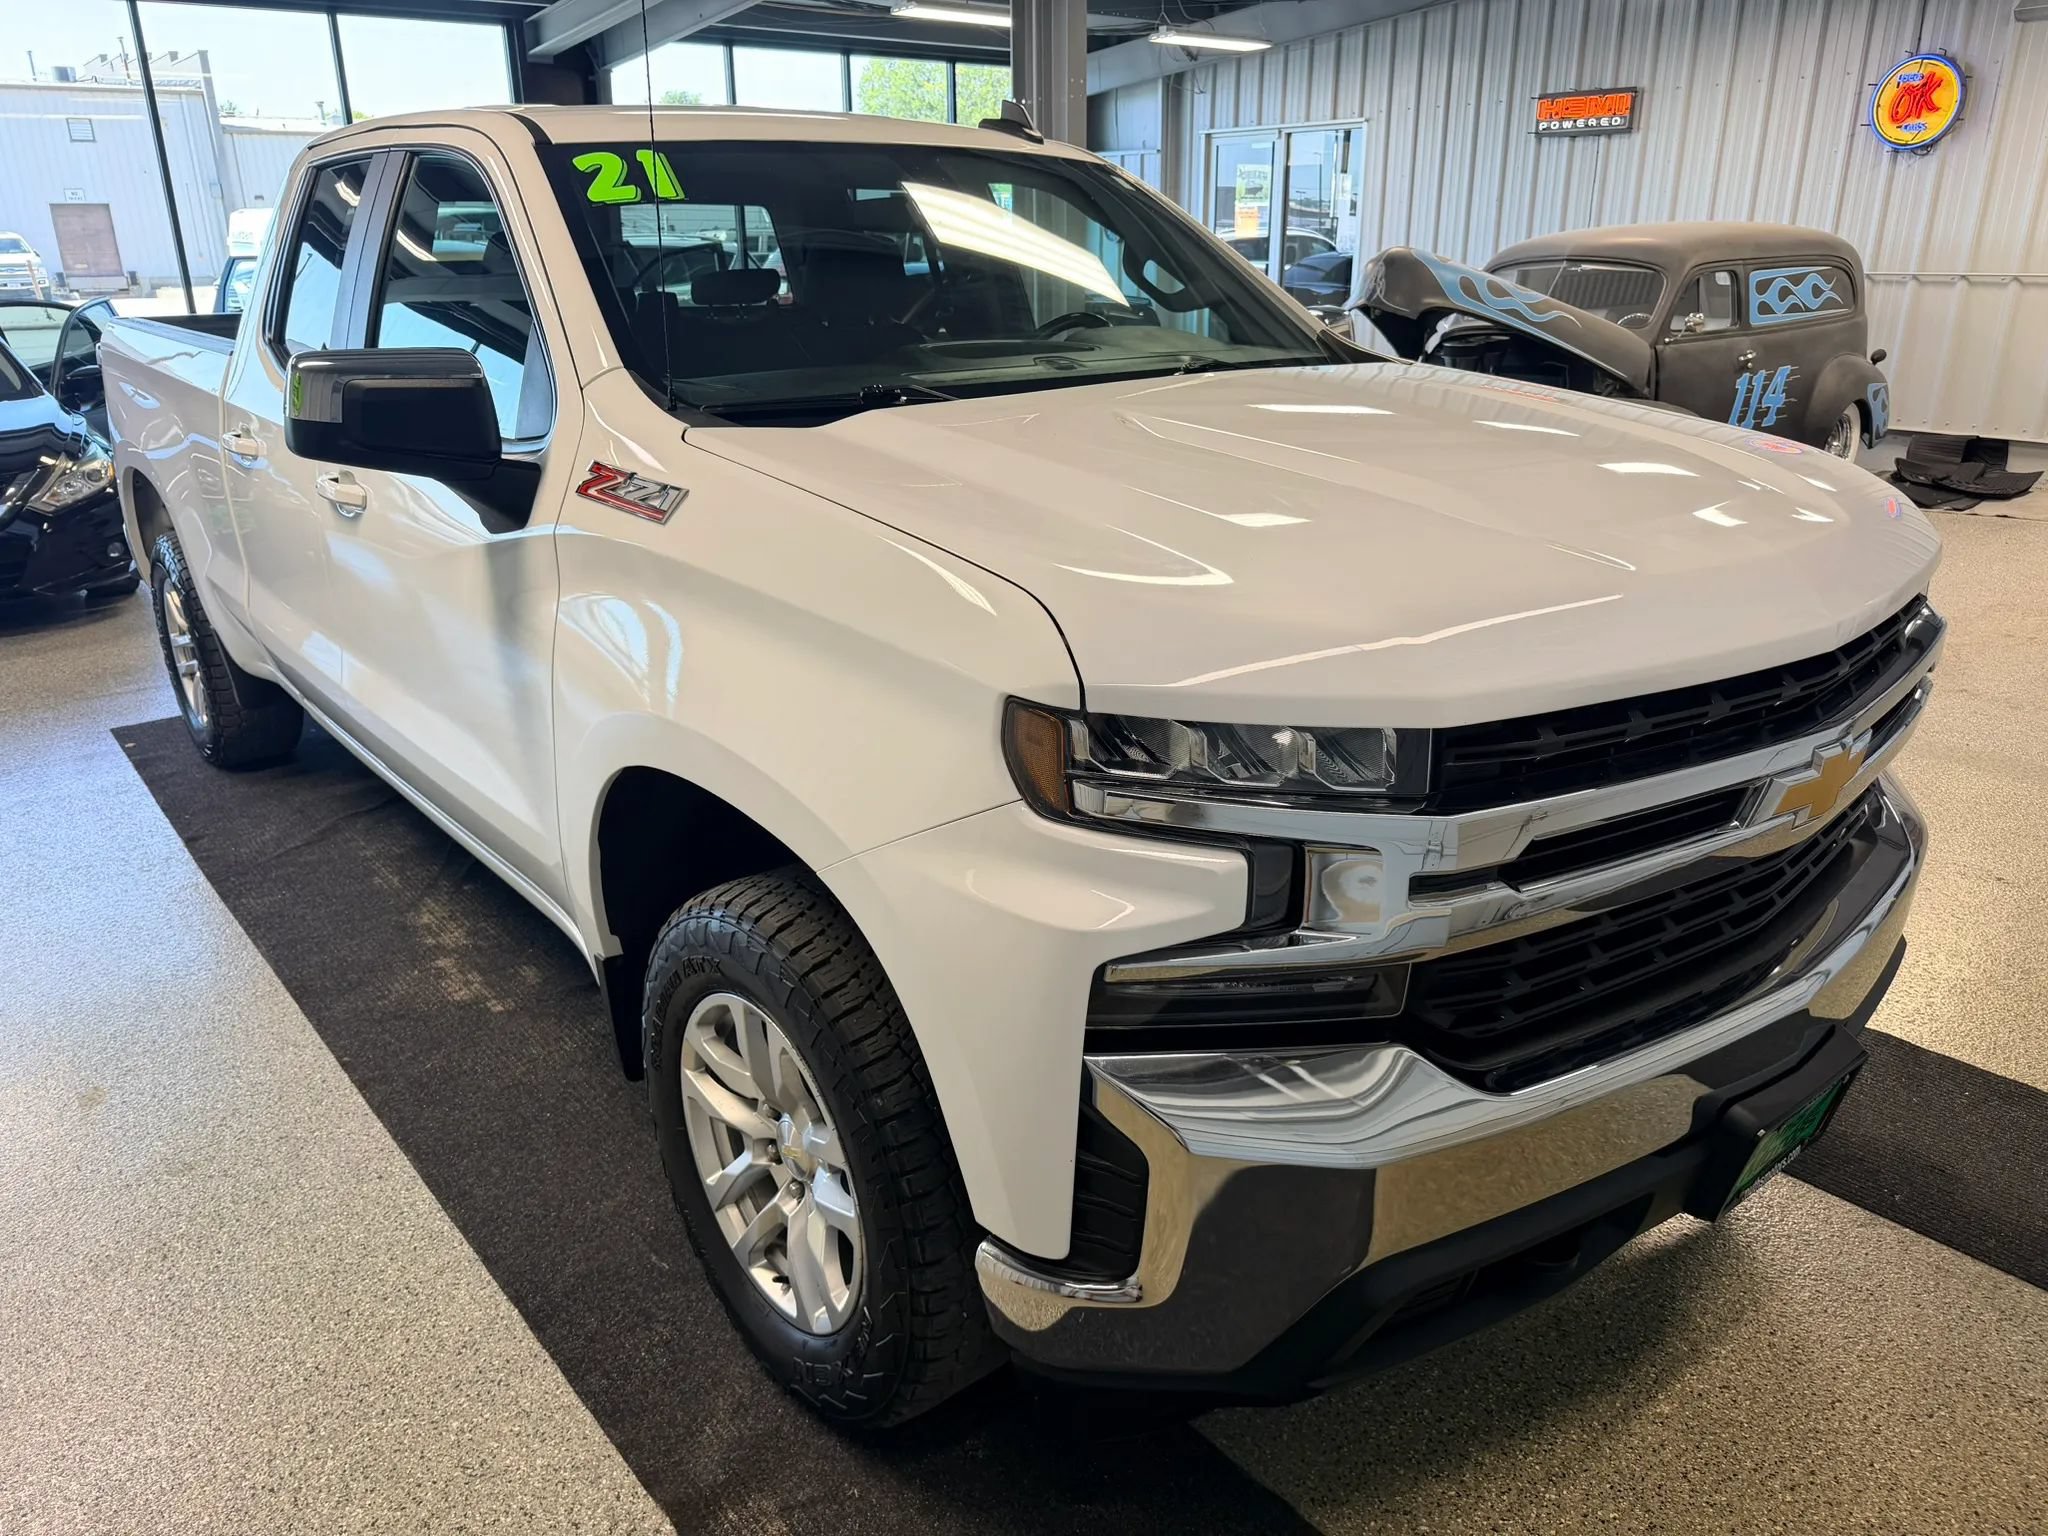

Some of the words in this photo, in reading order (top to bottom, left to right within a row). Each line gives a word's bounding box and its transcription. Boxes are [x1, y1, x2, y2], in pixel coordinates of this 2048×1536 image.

[1536, 92, 1632, 120] HEMI
[1538, 116, 1621, 131] POWERED
[1890, 71, 1943, 124] OK
[572, 148, 686, 205] 21
[1727, 365, 1792, 431] 114
[575, 459, 690, 526] Z71
